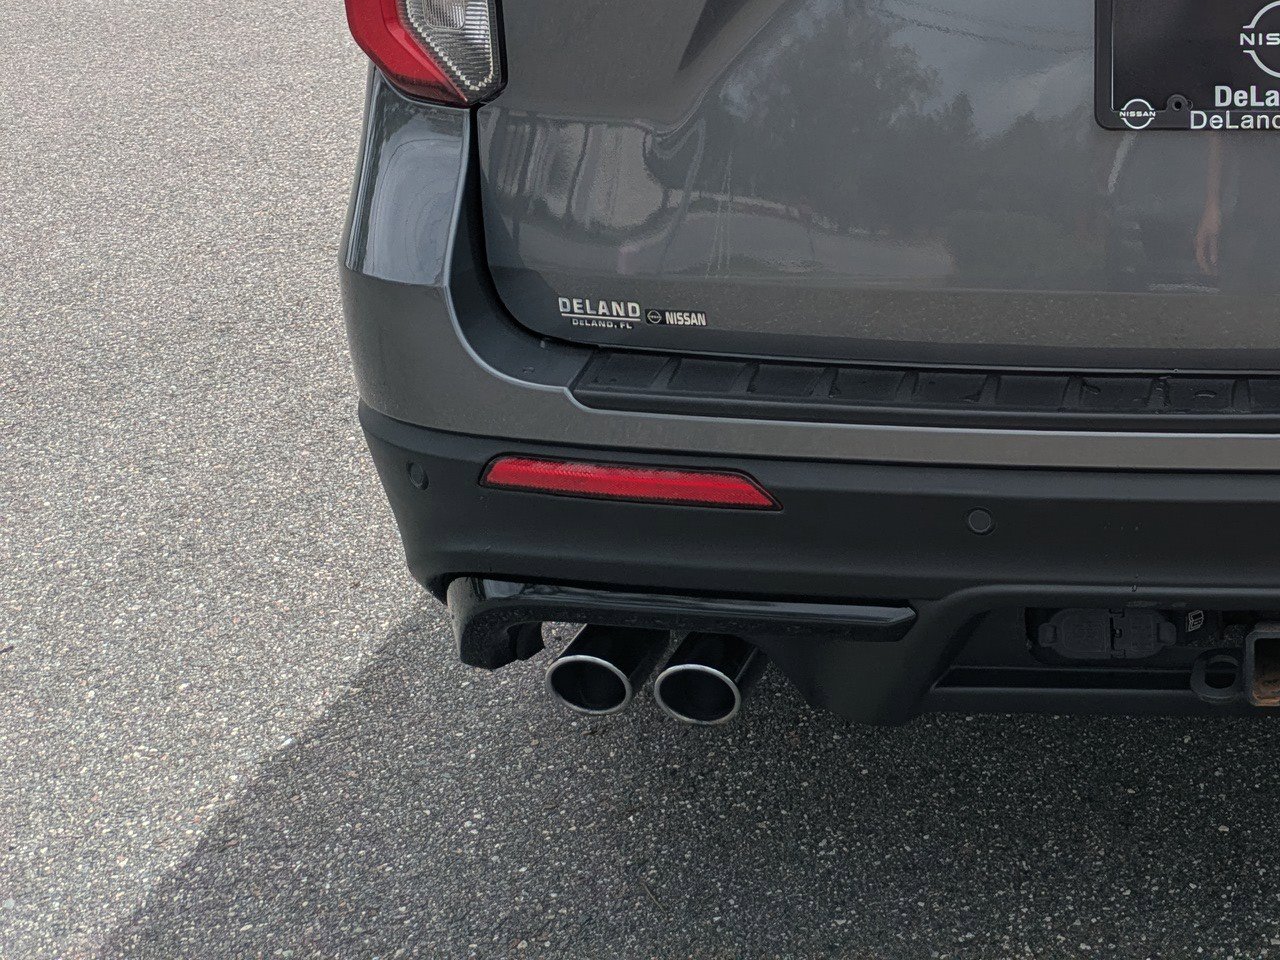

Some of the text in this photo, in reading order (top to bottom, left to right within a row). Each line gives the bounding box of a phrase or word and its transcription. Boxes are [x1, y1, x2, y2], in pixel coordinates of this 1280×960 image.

[1119, 110, 1156, 118] NISSAN
[558, 296, 641, 318] DELAND
[664, 311, 707, 327] NISSAN
[619, 321, 633, 330] FL
